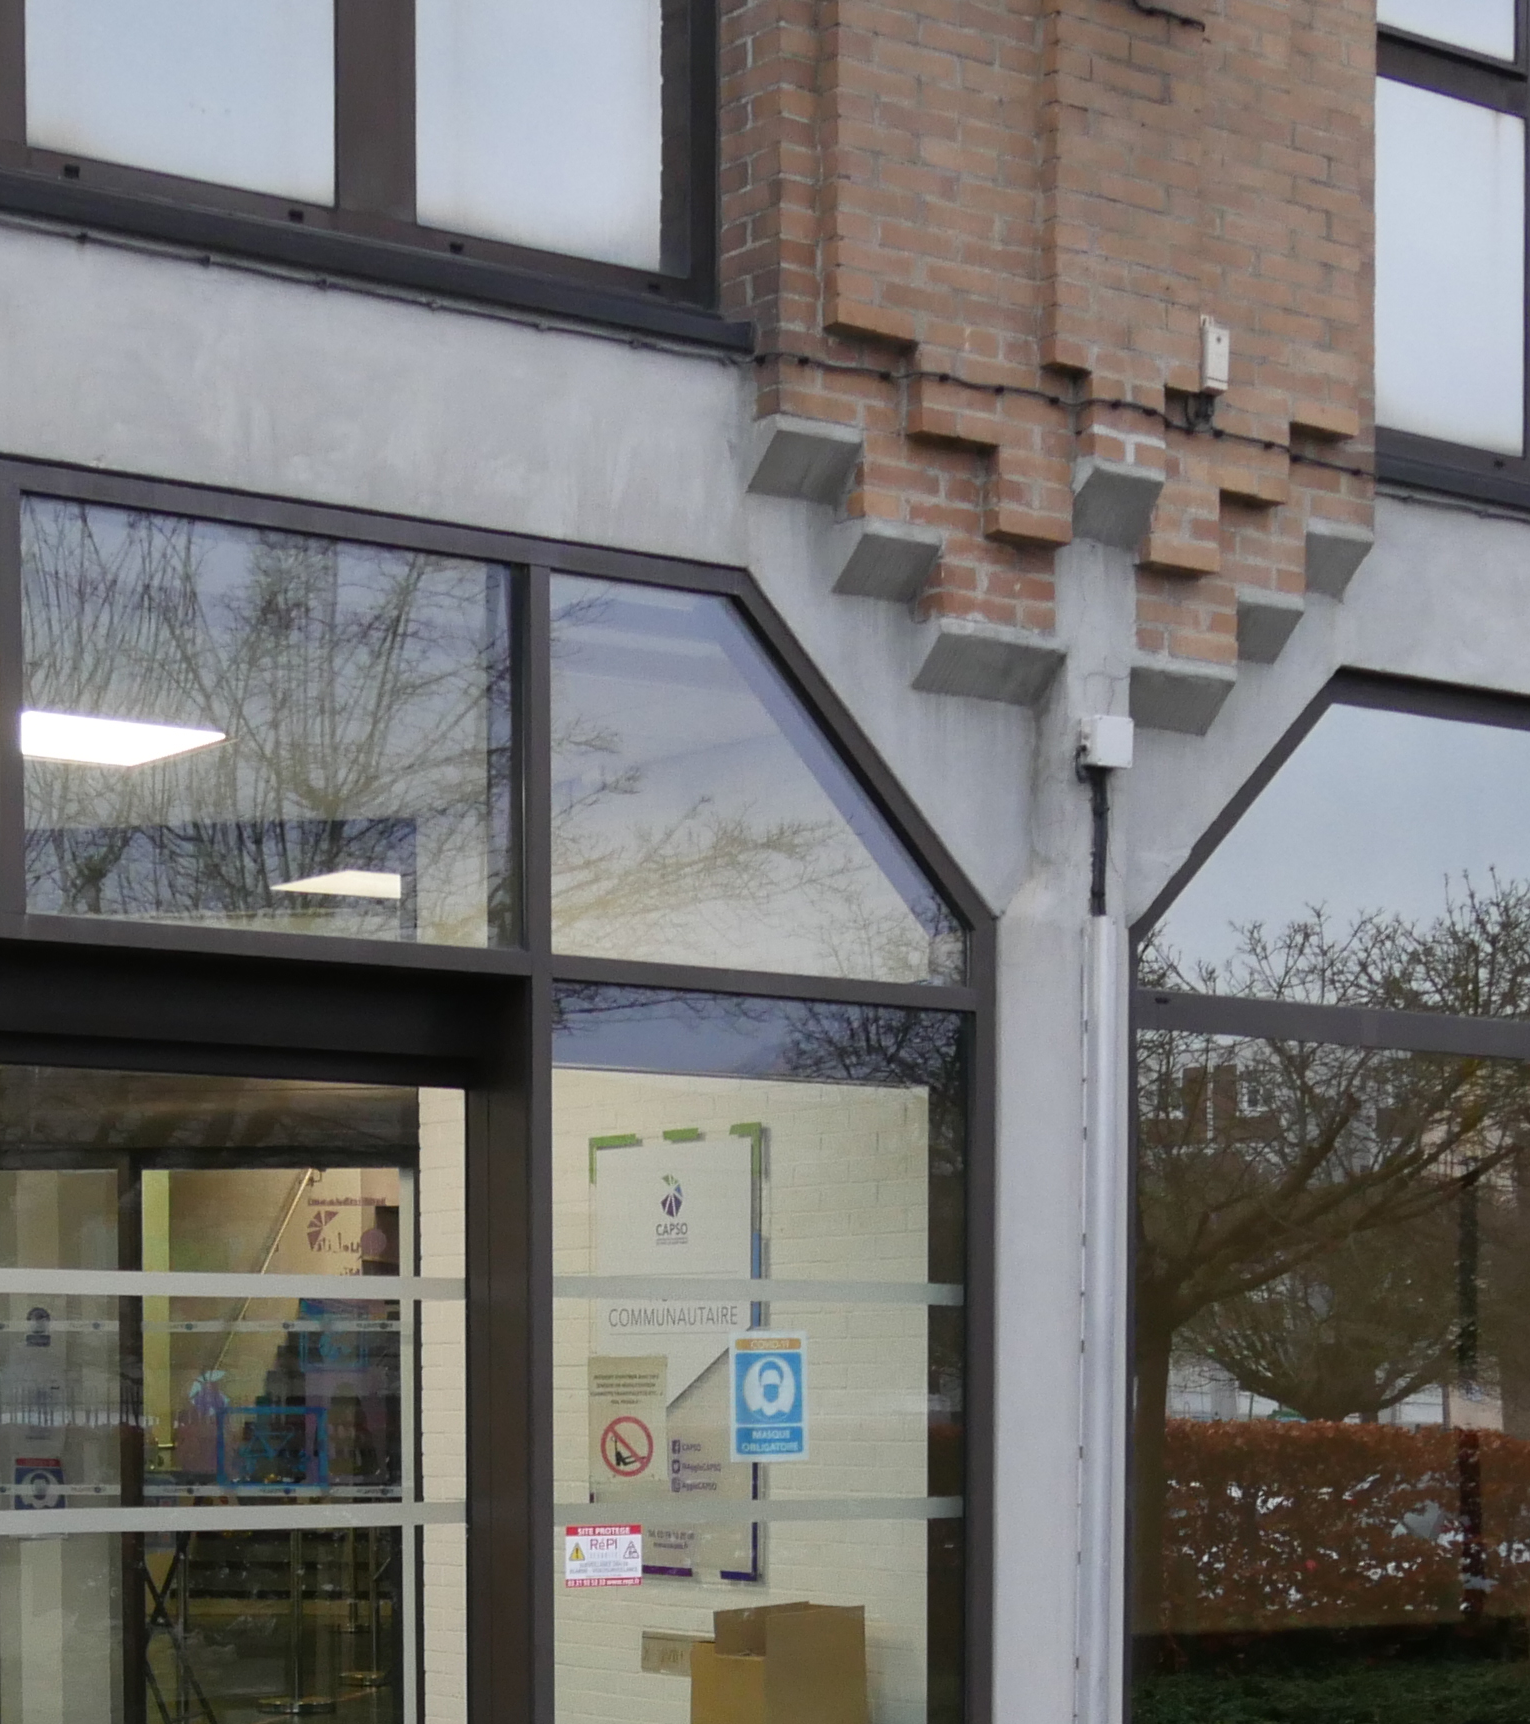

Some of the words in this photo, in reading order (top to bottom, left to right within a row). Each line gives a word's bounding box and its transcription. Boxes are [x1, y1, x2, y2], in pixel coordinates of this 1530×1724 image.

[655, 1222, 689, 1237] CAPSO
[608, 1305, 739, 1328] COMMUNAUTAIRE
[751, 1429, 791, 1440] MASQUE
[741, 1441, 800, 1453] OBLIGATOIRE
[577, 1527, 594, 1536] SITE
